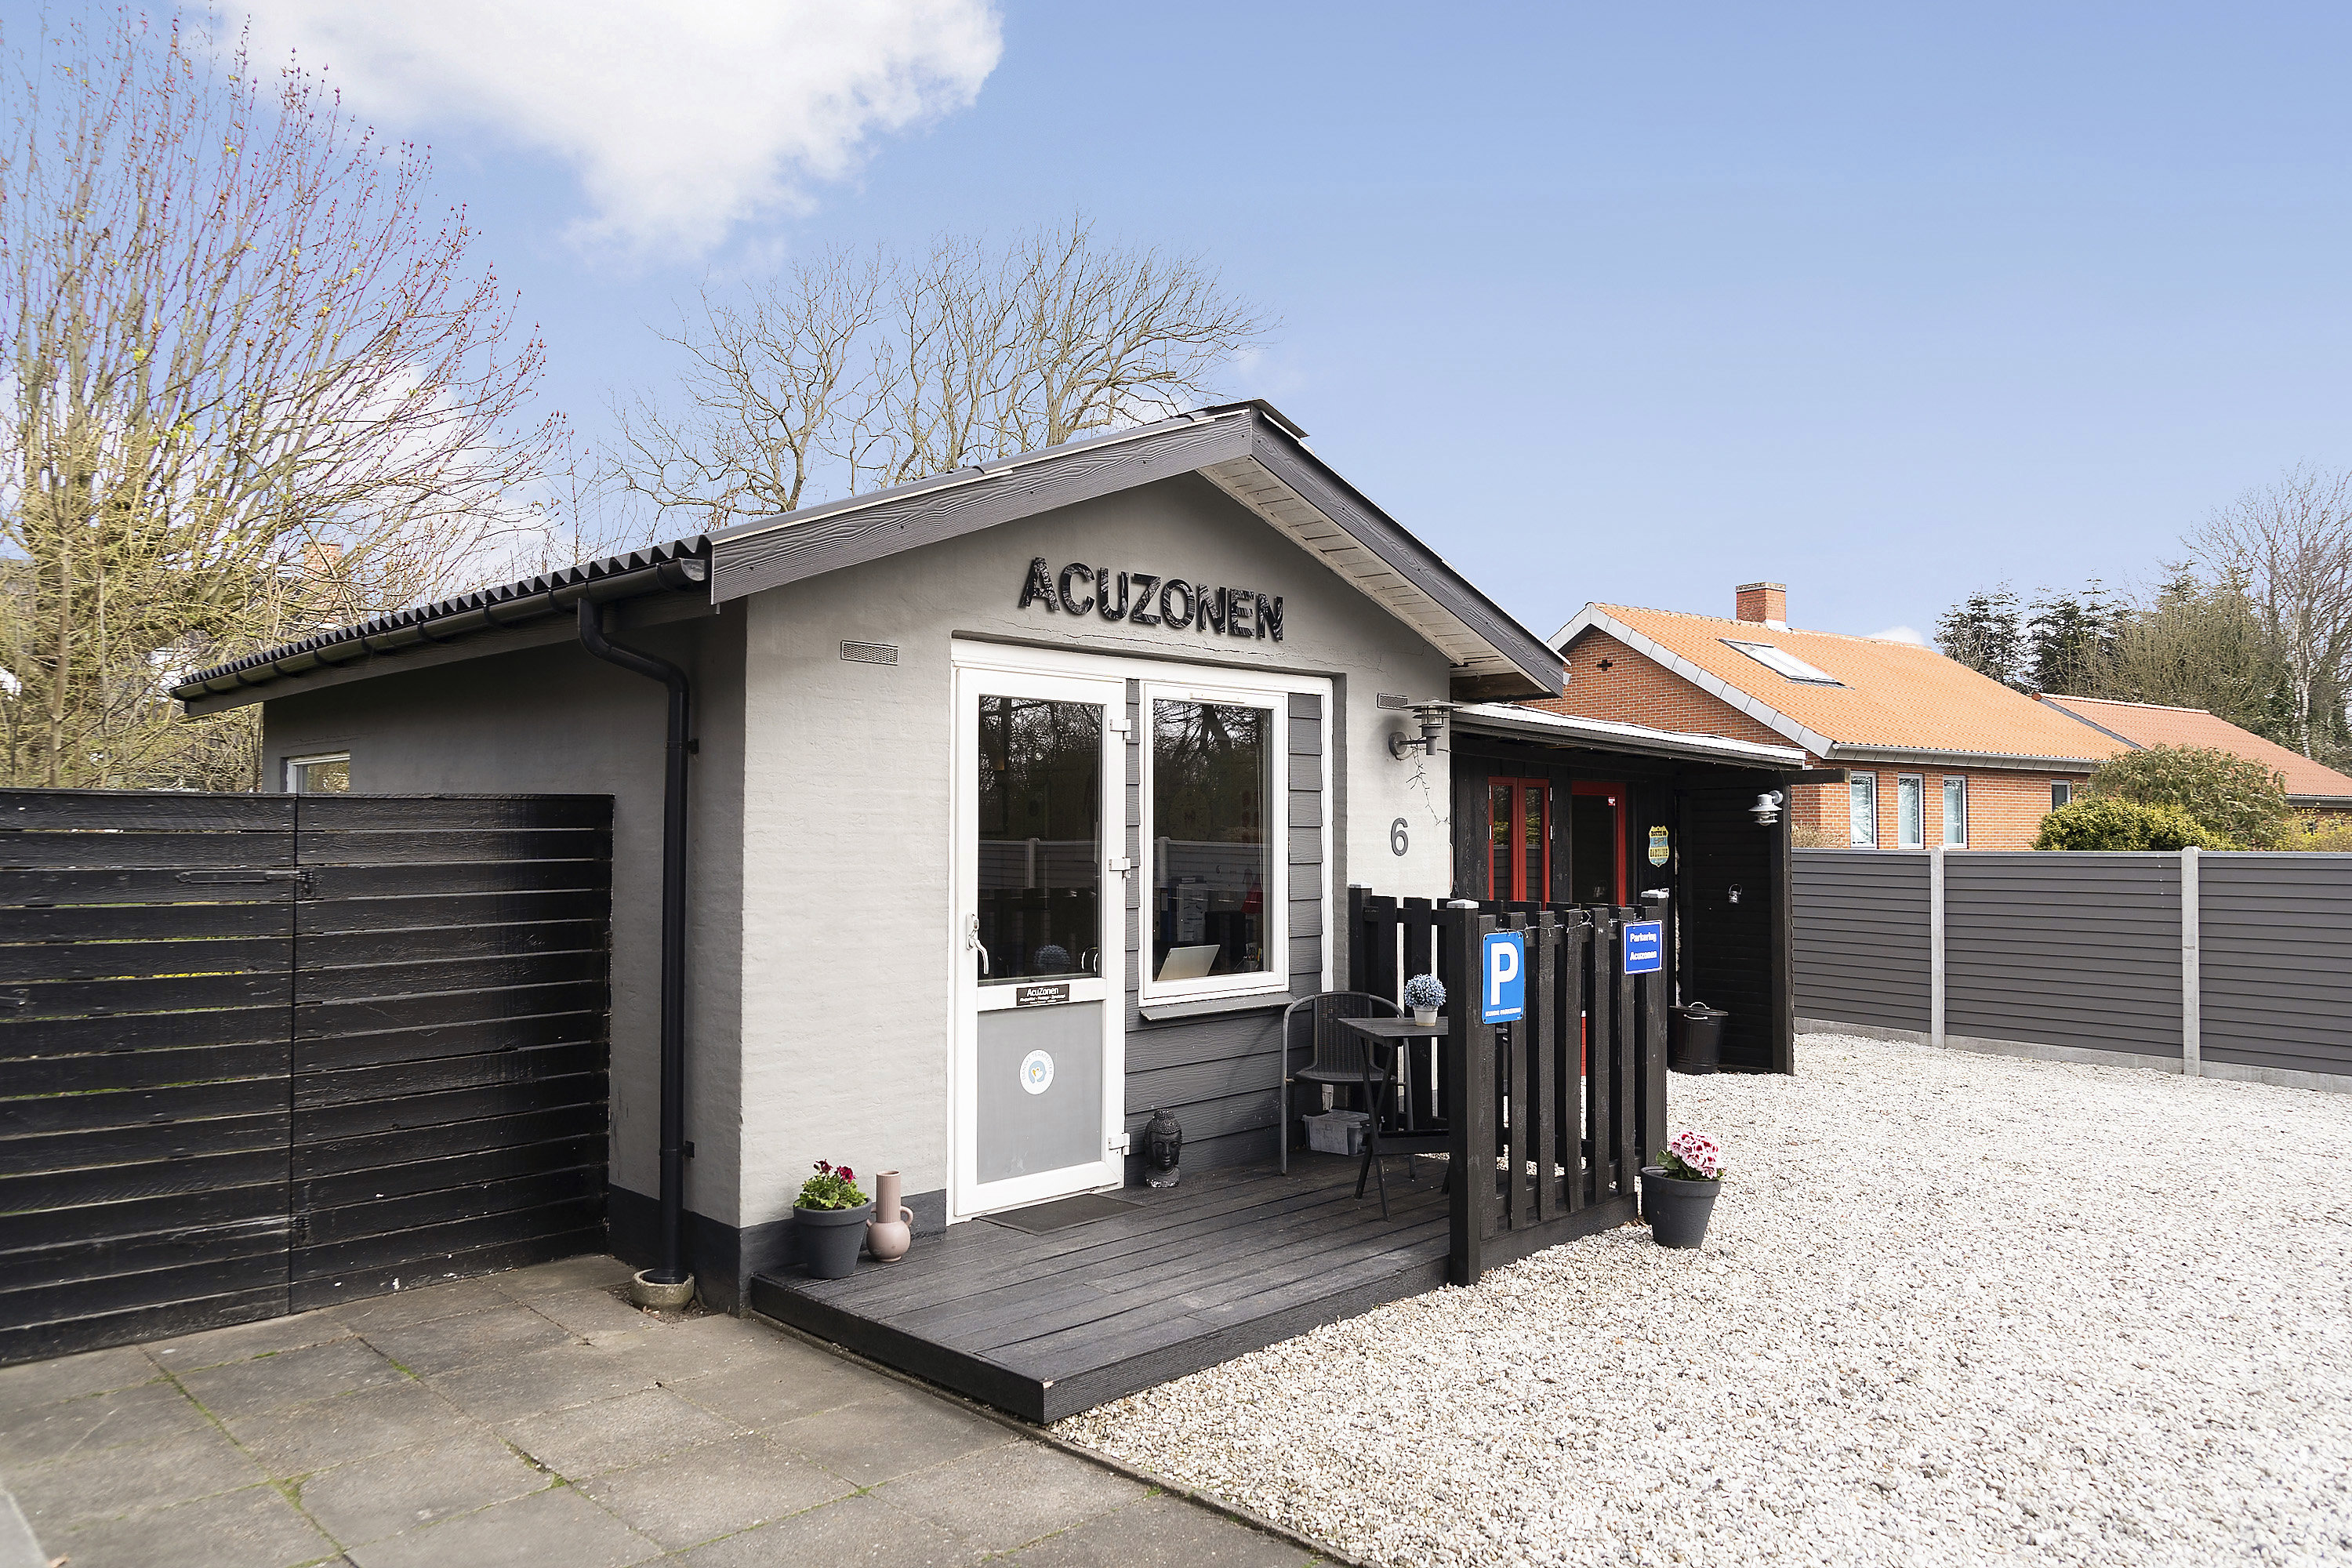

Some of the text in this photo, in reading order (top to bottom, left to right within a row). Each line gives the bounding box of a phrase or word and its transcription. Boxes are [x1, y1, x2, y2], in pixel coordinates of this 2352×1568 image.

[1018, 557, 1284, 641] ACUZONEN
[1391, 818, 1408, 856] 6
[1630, 931, 1657, 943] Parkering
[1629, 950, 1657, 961] Acuzonen
[1490, 942, 1519, 1006] P
[1026, 987, 1059, 997] AcuZonen
